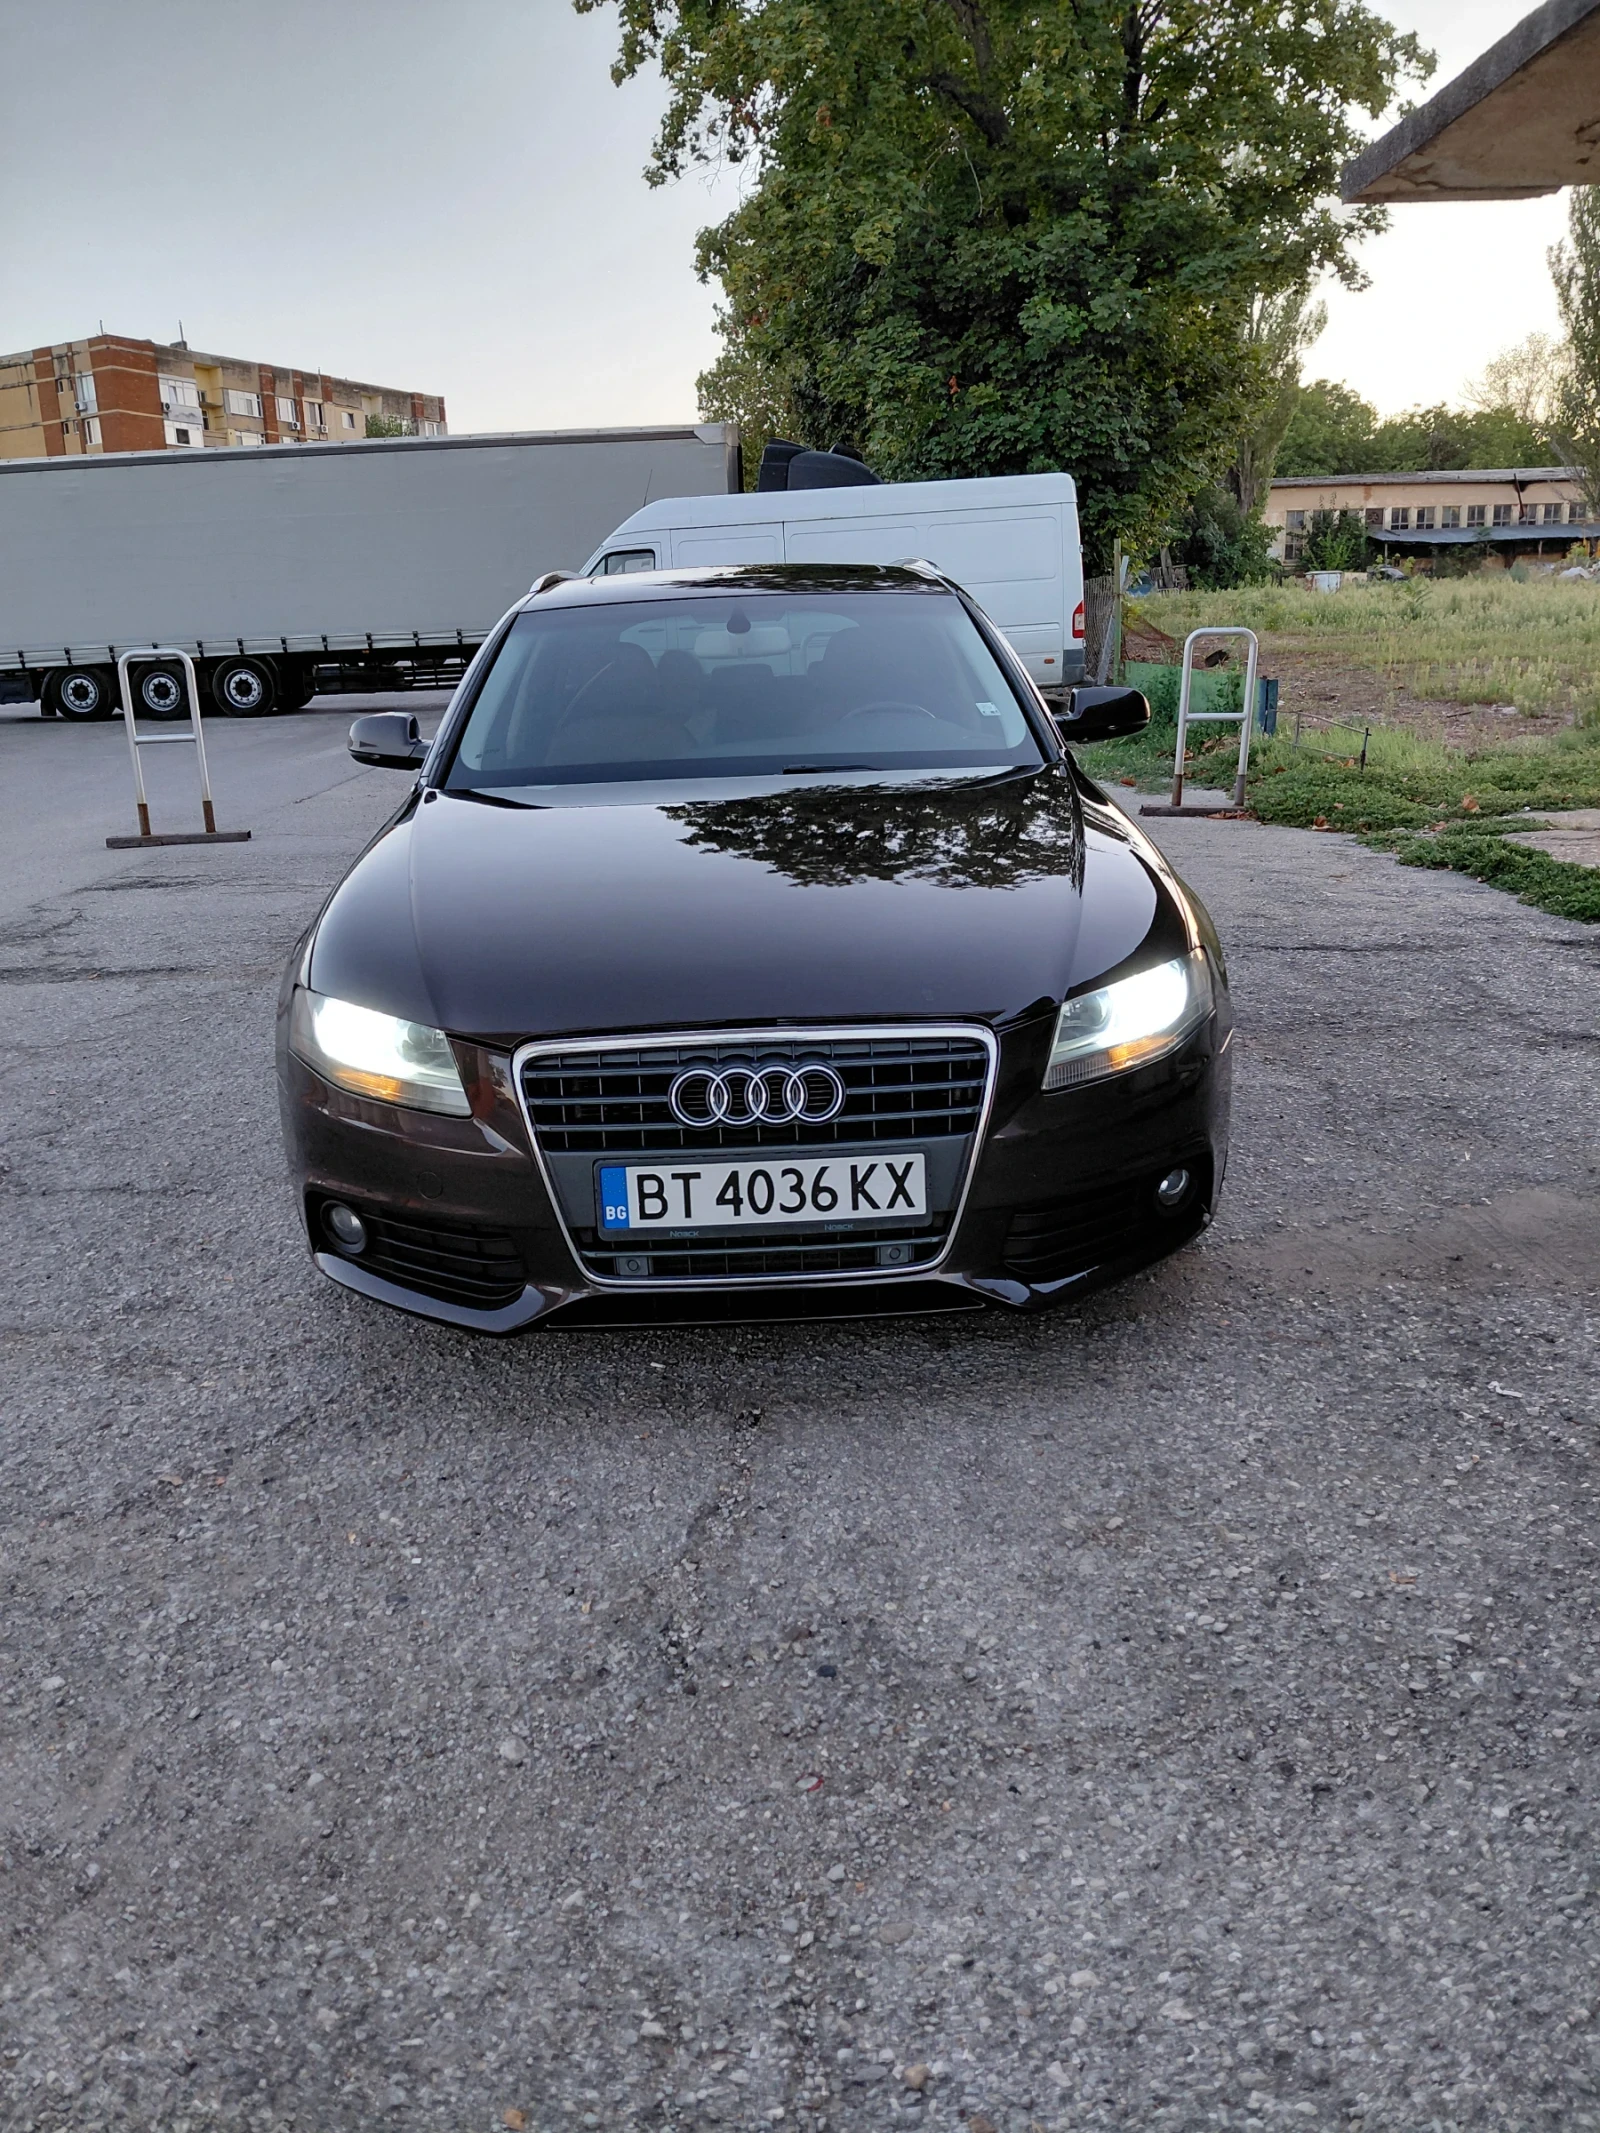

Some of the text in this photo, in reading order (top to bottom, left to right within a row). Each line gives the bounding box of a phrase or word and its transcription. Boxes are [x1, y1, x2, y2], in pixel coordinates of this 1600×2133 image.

[636, 1161, 916, 1220] BT 4036 KX
[605, 1205, 627, 1220] BG
